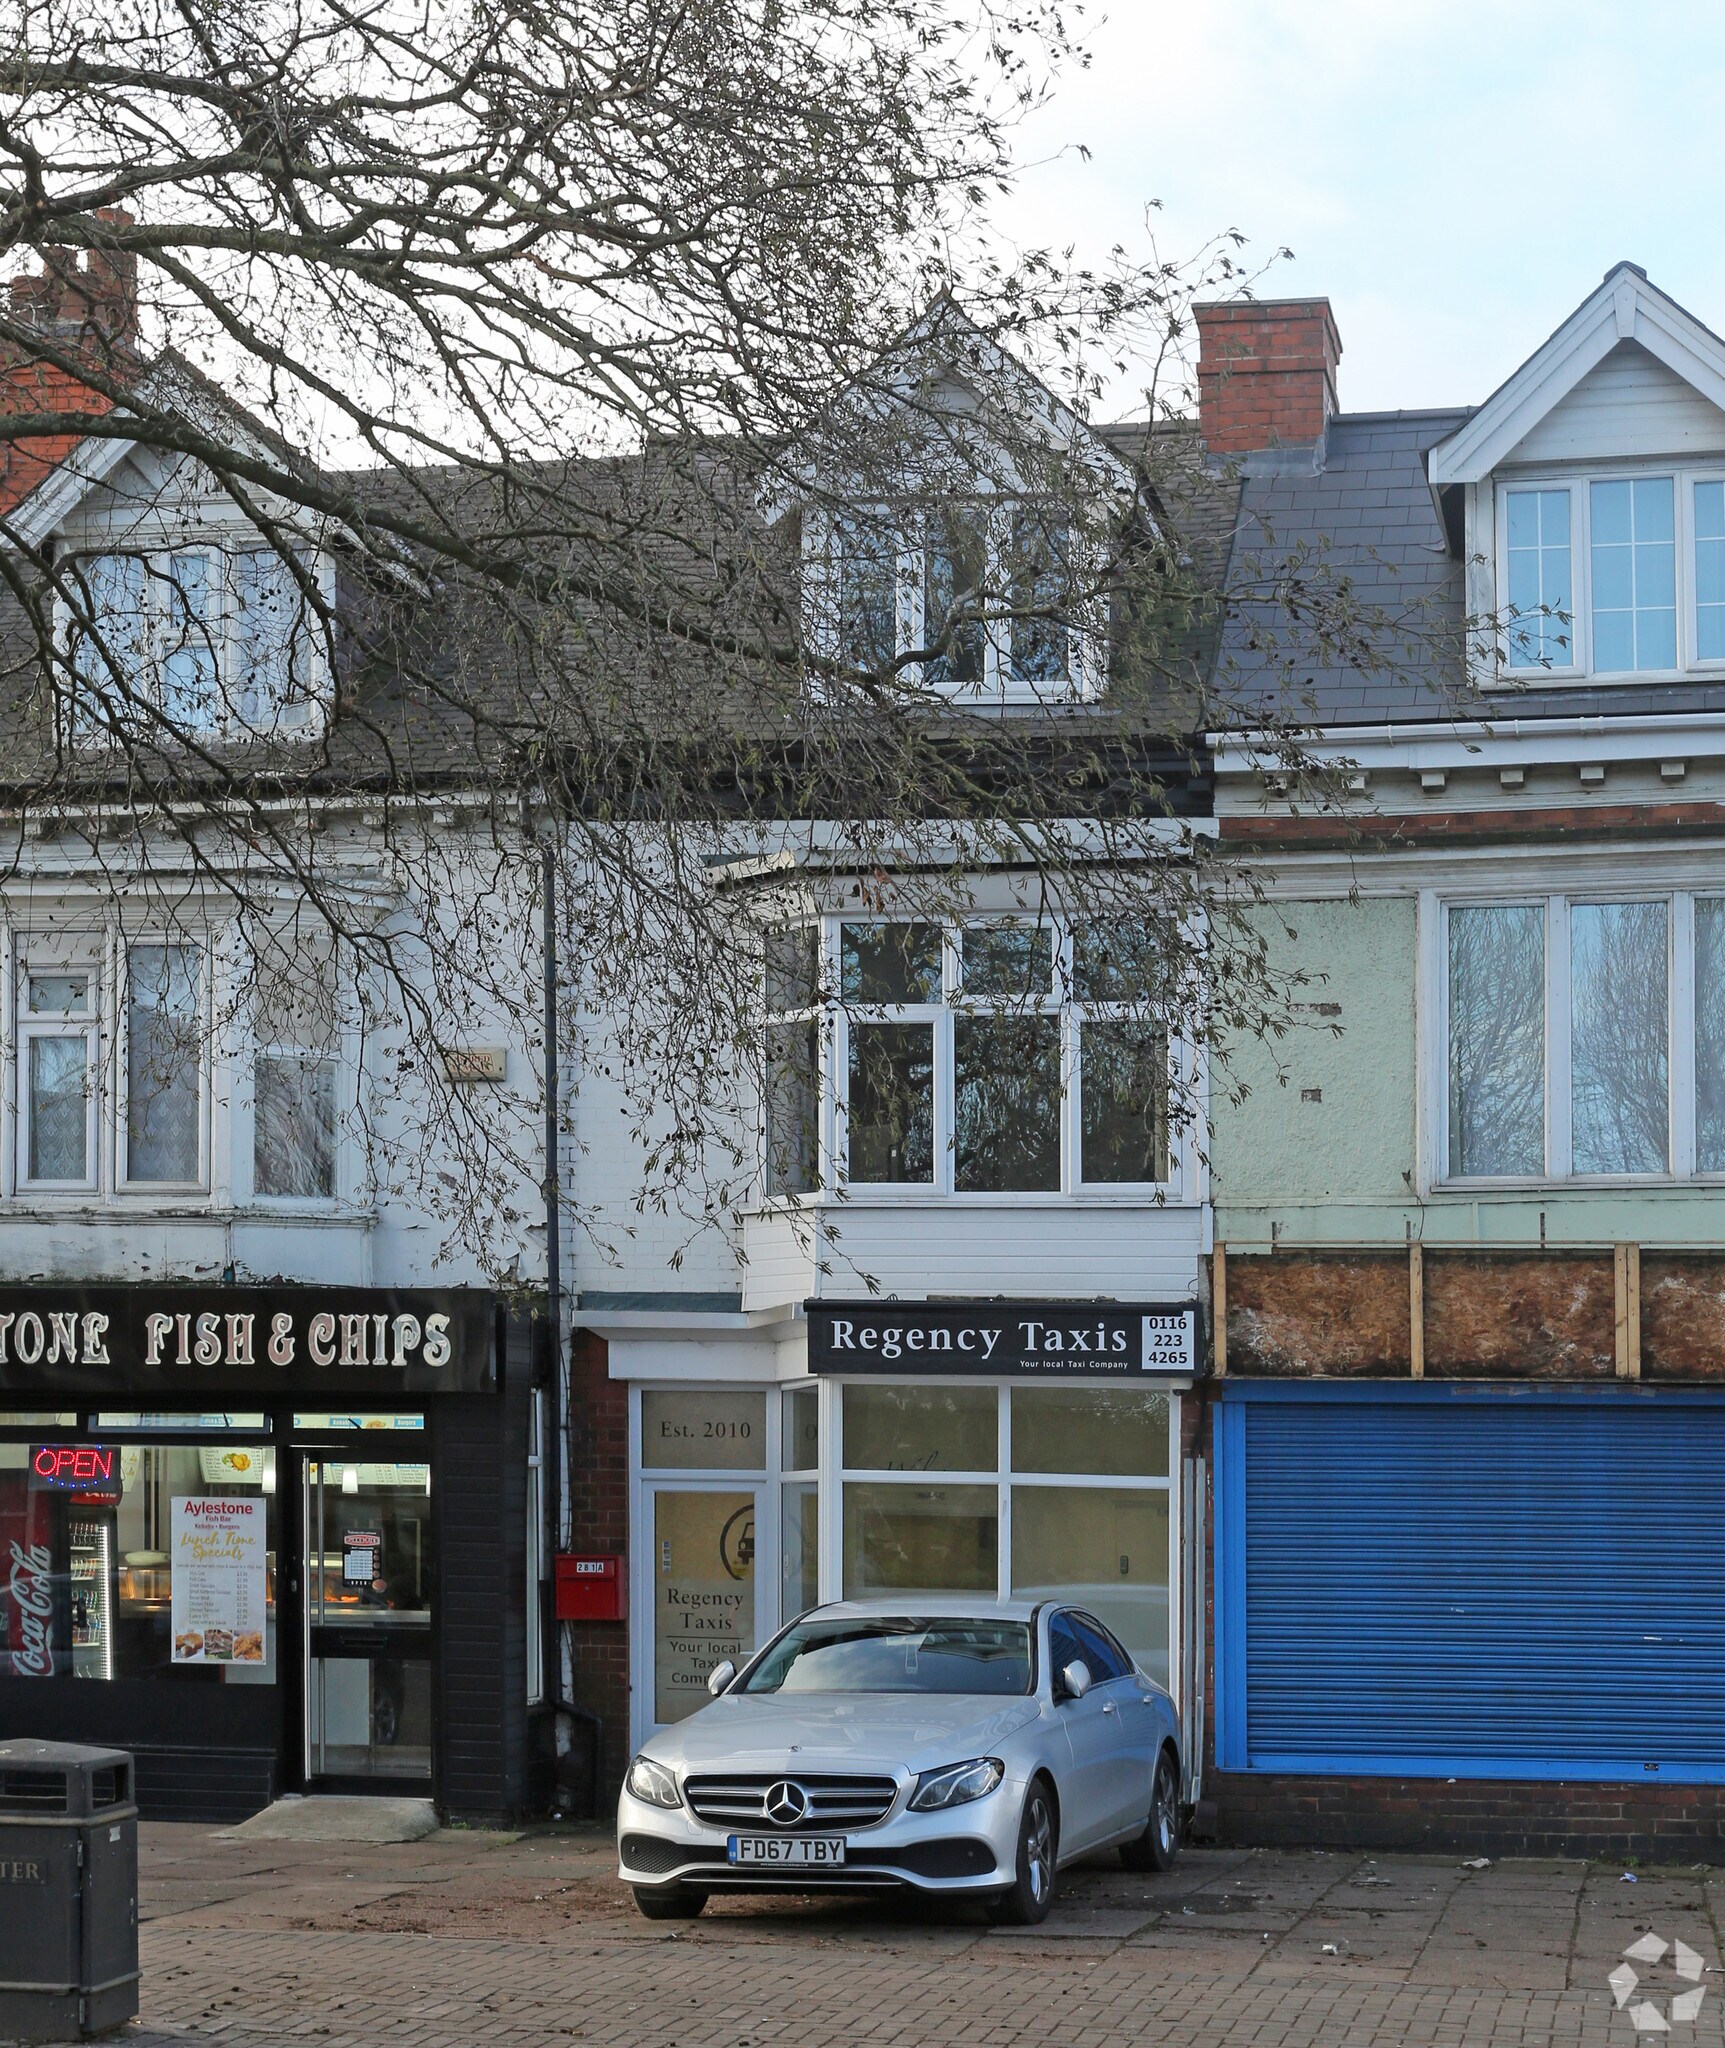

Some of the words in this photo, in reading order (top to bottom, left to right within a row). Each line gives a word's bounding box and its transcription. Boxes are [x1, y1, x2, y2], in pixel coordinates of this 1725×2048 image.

[1149, 1317, 1188, 1330] 0116
[145, 1312, 255, 1366] FISH
[268, 1312, 296, 1366] &
[308, 1312, 451, 1367] CHIPS
[830, 1320, 1002, 1360] Regency
[1018, 1321, 1128, 1352] Taxis
[1153, 1334, 1183, 1347] 223
[1020, 1360, 1039, 1368] Your
[1043, 1360, 1064, 1368] local
[1068, 1360, 1086, 1368] Taxi
[1089, 1360, 1128, 1370] Company
[1148, 1351, 1188, 1364] 4265
[661, 1420, 695, 1438] Est.
[703, 1421, 751, 1438] 2010
[35, 1449, 112, 1478] OPEN
[184, 1501, 253, 1516] Aylestone
[181, 1531, 220, 1547] Lunch
[225, 1531, 257, 1546] Time
[192, 1544, 245, 1561] Specials
[578, 1563, 603, 1572] 281A
[667, 1588, 744, 1610] Regency
[679, 1612, 732, 1630] Taxis
[670, 1641, 702, 1653] Your
[708, 1642, 741, 1654] local
[691, 1657, 720, 1669] Taxi
[671, 1672, 710, 1686] Comp
[740, 1840, 793, 1860] FD67
[800, 1841, 841, 1860] TBY
